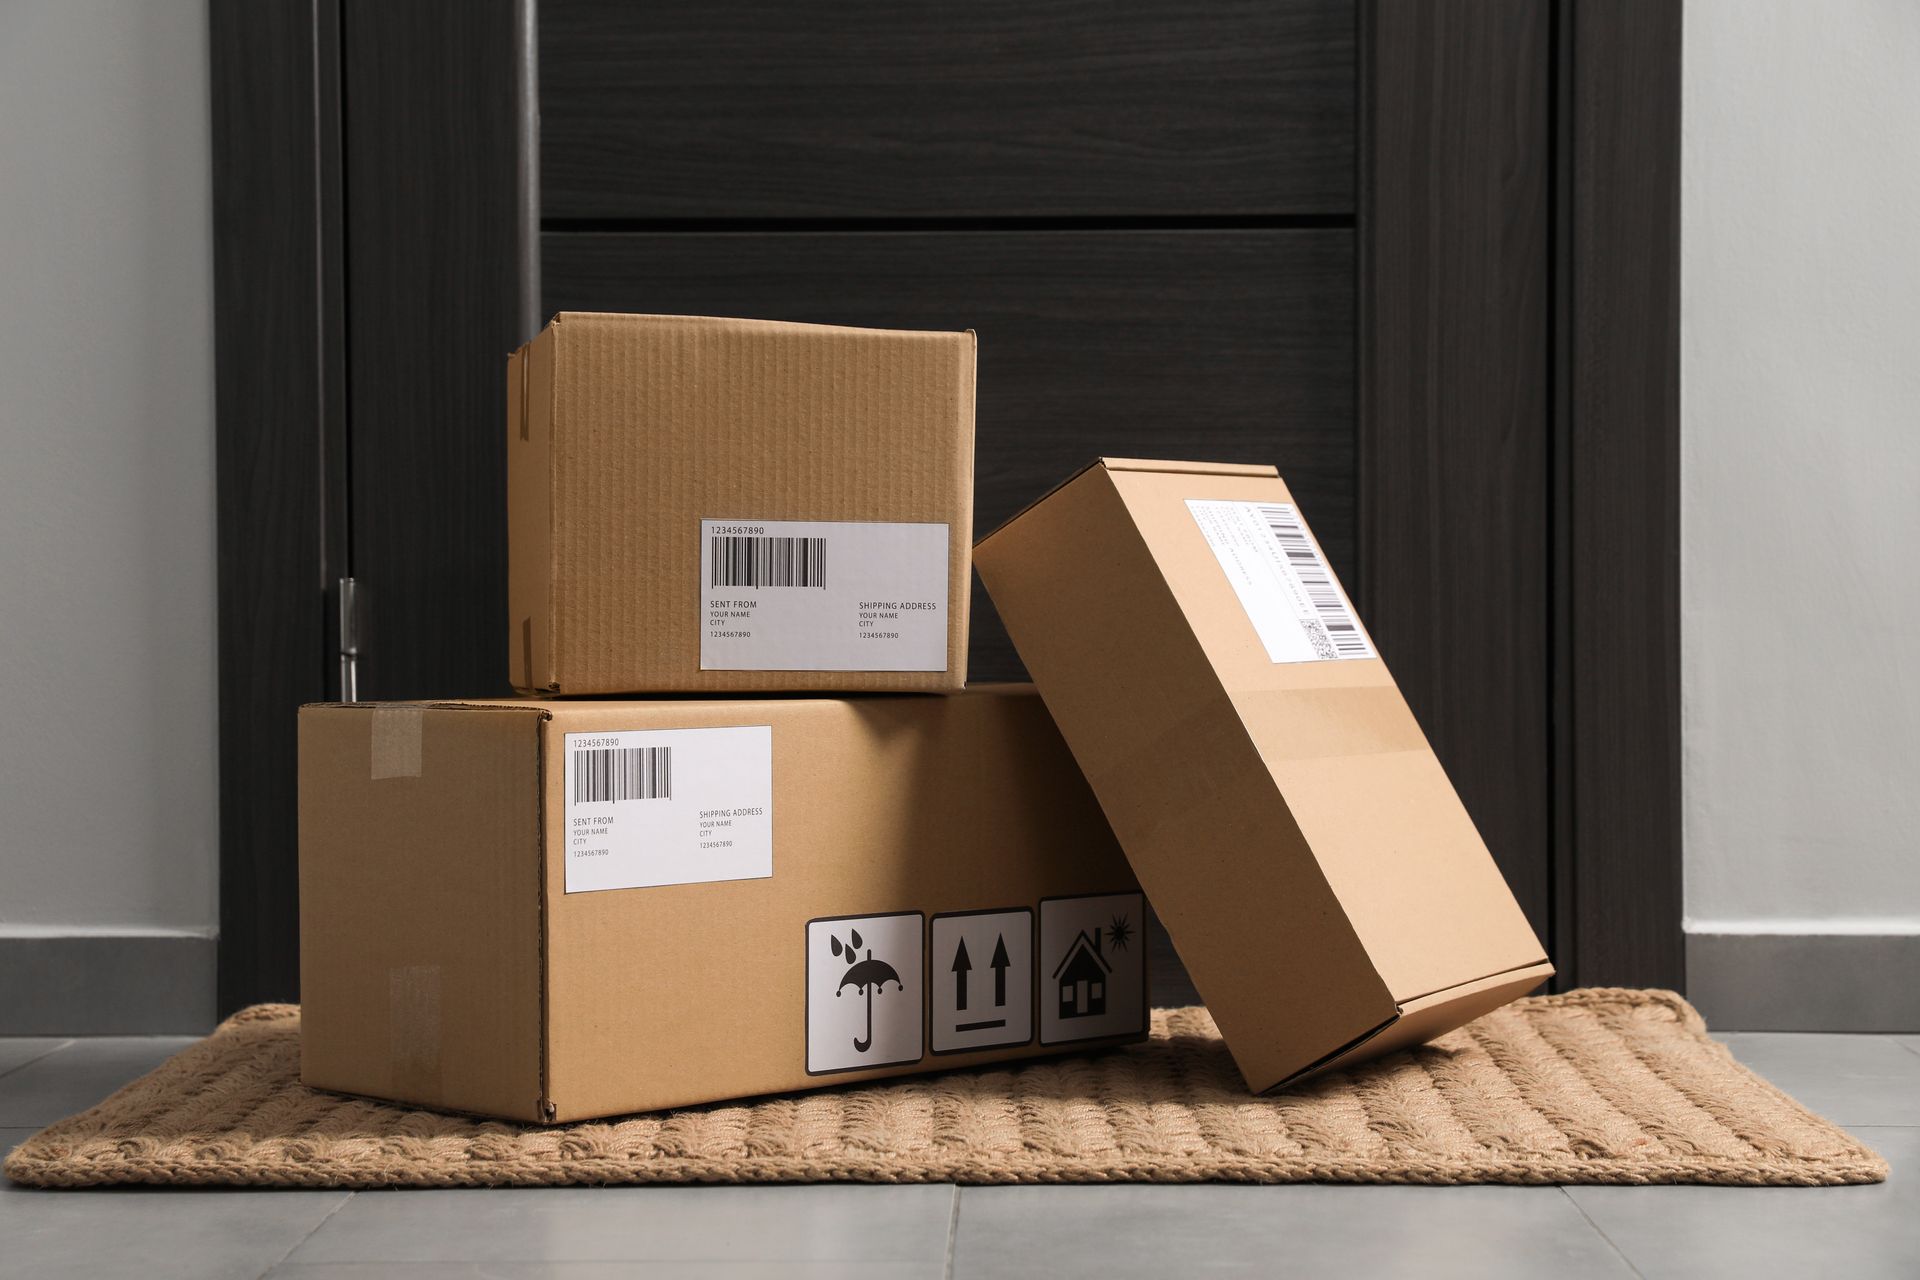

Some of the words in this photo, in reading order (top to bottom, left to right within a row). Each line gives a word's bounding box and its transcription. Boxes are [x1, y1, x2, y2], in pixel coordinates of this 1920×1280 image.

[711, 526, 765, 535] 1234567890
[710, 600, 731, 609] SENT
[733, 600, 757, 609] FROM
[859, 601, 898, 610] SHIPPING
[899, 602, 937, 611] ADDRESS
[573, 738, 619, 748] 1234567890
[699, 809, 731, 819] SHIPPING
[732, 807, 763, 817] ADDRESS
[573, 818, 592, 827] SENT
[593, 816, 614, 825] FROM
[573, 828, 590, 836] YOUR
[699, 830, 712, 838] CITY
[573, 838, 587, 846] CITY
[699, 840, 733, 849] 1234567890
[573, 849, 609, 858] 1234567890
